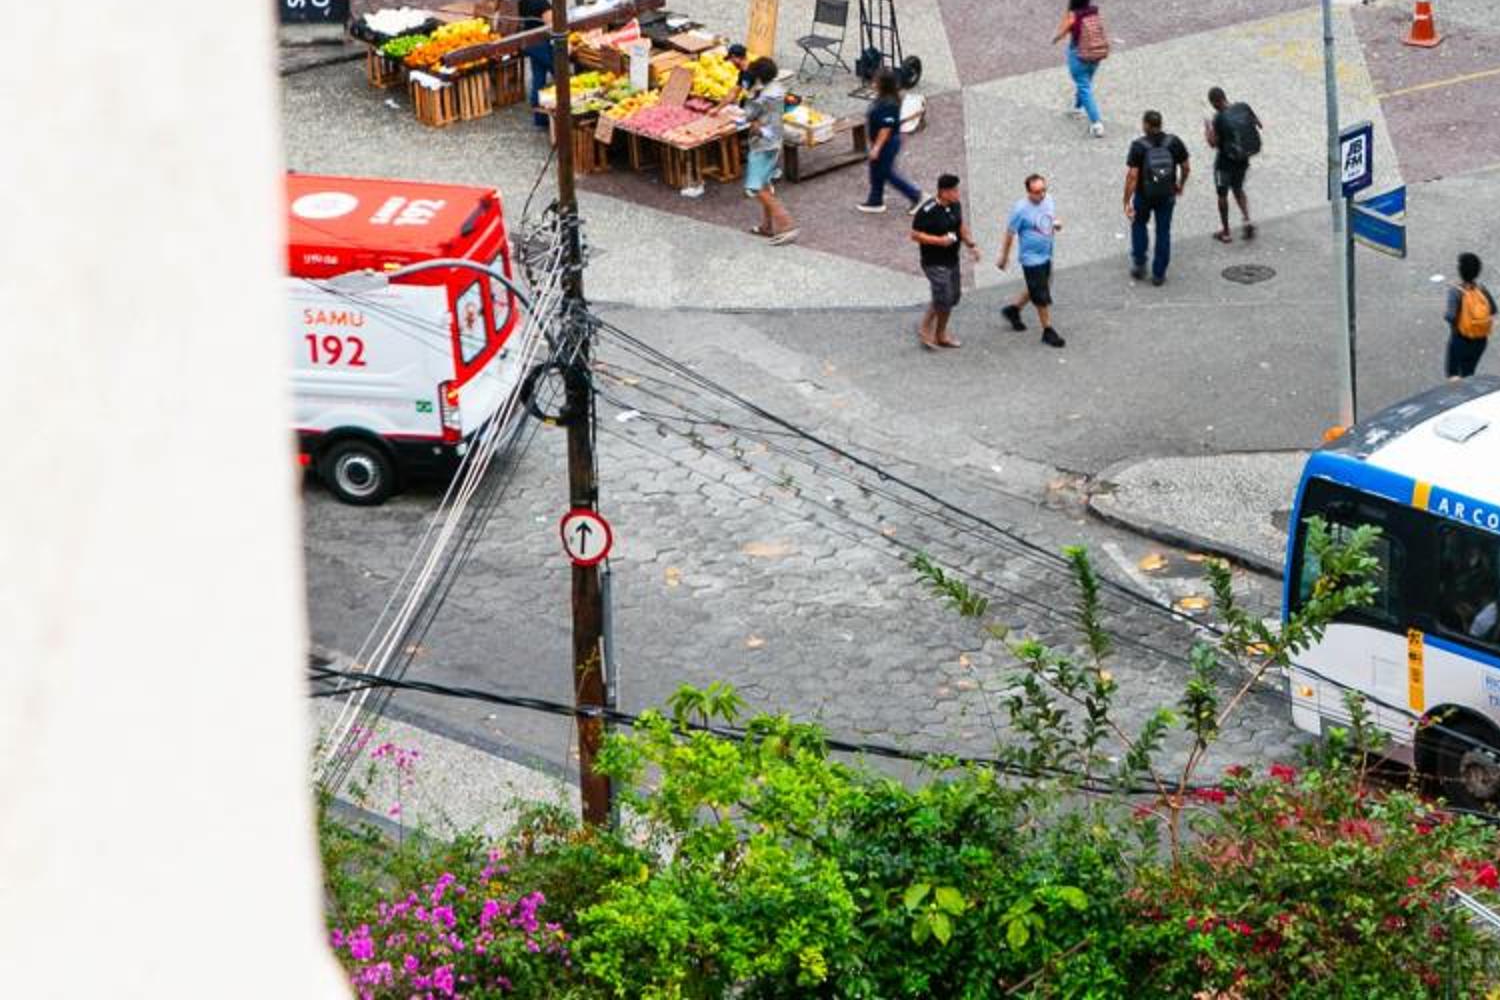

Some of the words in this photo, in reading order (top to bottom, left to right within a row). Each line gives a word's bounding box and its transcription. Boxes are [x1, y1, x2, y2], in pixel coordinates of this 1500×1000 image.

[303, 309, 366, 328] SAMU
[305, 333, 367, 367] 192
[1438, 497, 1465, 520] AR
